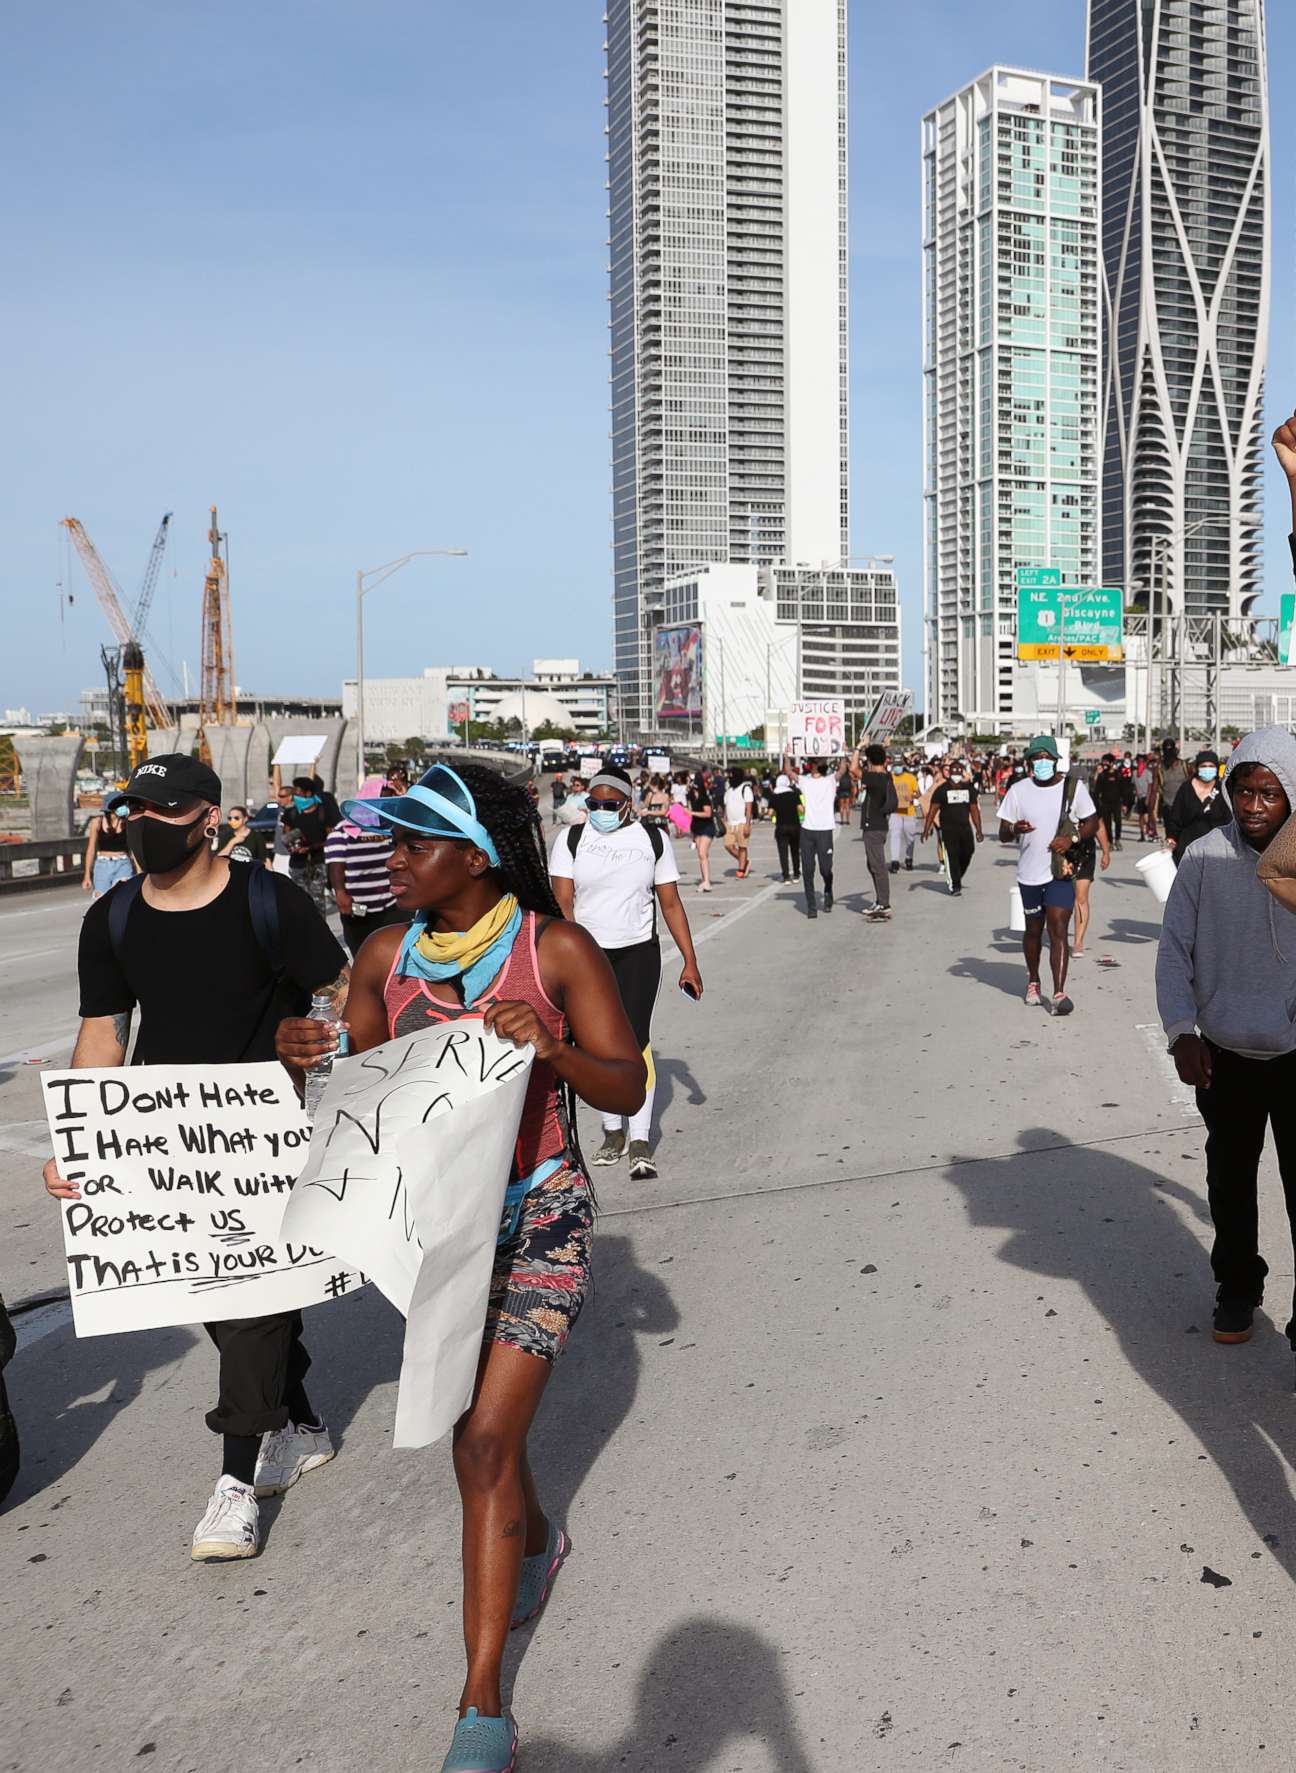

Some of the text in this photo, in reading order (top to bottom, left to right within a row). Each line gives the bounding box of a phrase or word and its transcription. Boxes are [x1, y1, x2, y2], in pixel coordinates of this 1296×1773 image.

[1043, 575, 1056, 584] 2A
[1056, 592, 1078, 602] 2nd
[1037, 648, 1104, 656] EXIT ONLY
[791, 702, 839, 715] JUSTICE
[805, 716, 841, 735] FOR
[792, 737, 840, 756] FLOYD
[134, 764, 168, 779] NIKE
[47, 1079, 95, 1120] I
[55, 1126, 89, 1163] I
